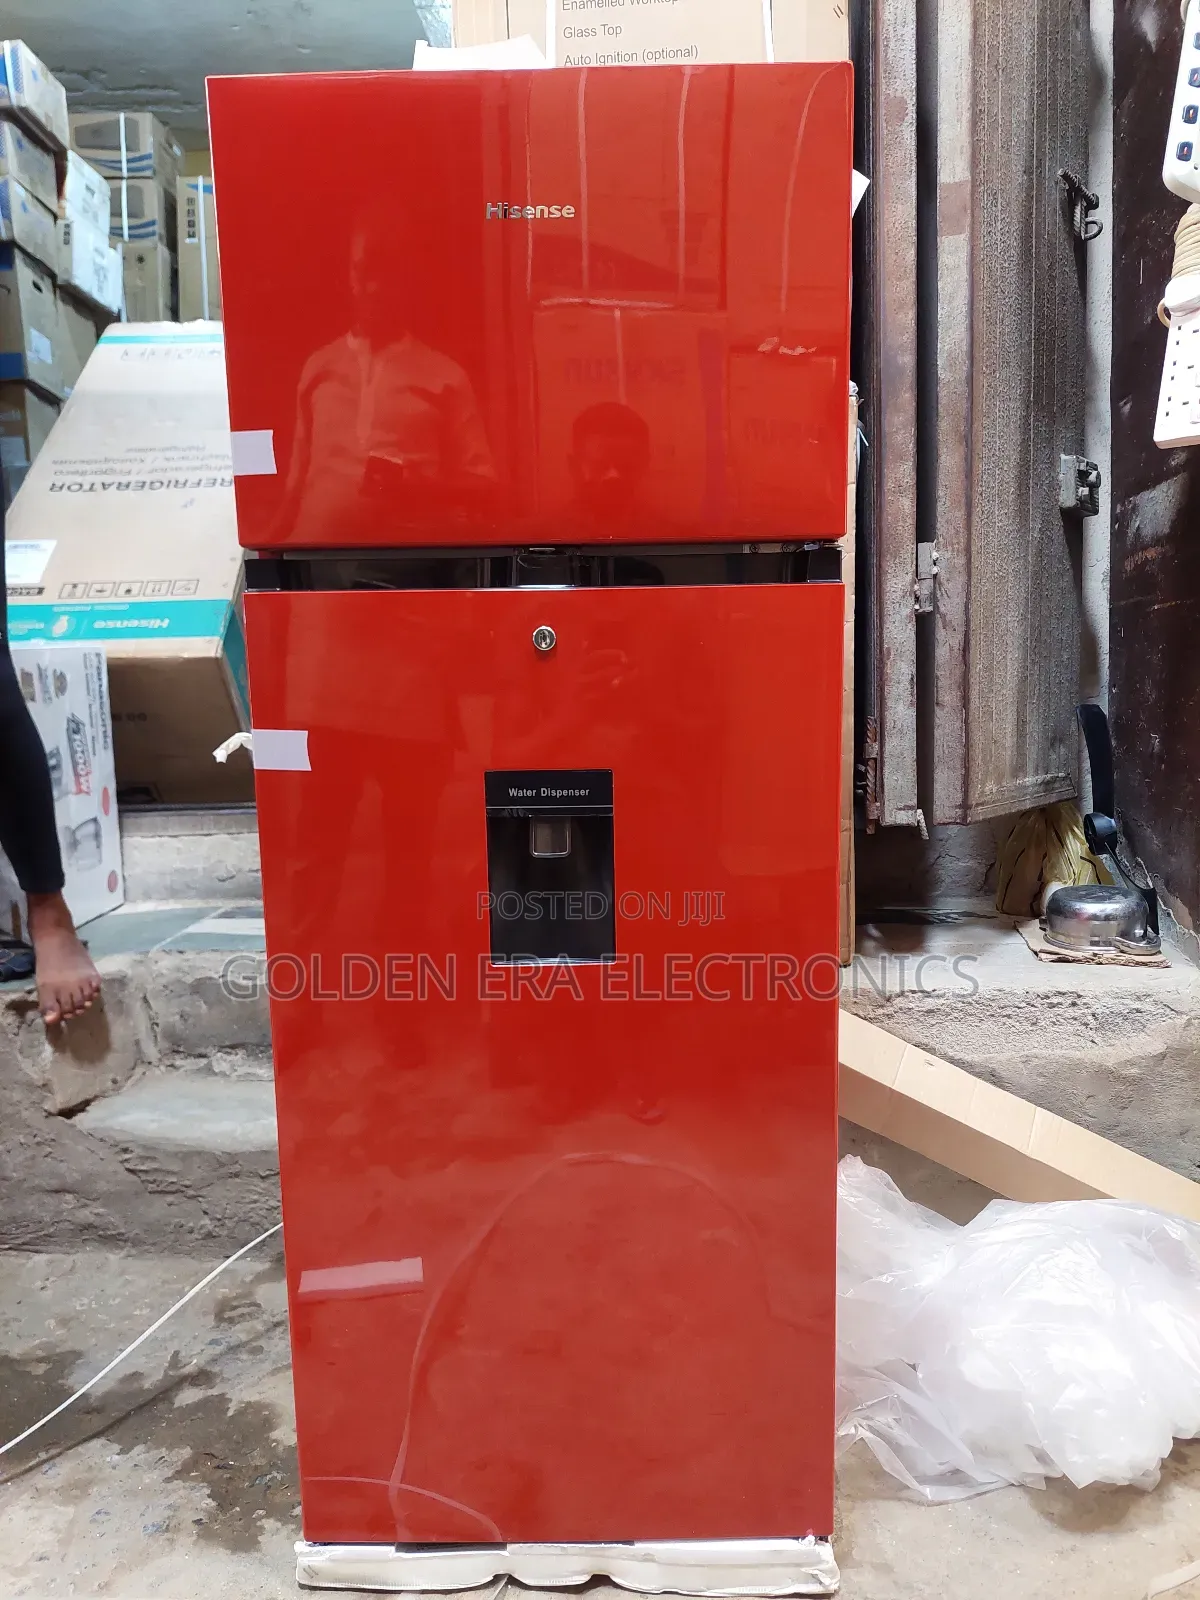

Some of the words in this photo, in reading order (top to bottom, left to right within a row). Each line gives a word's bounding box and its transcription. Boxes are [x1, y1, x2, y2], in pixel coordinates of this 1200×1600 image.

[562, 0, 625, 11] Enamelled
[563, 26, 597, 39] Glass
[600, 24, 622, 38] Top
[564, 54, 591, 66] Auto
[595, 51, 638, 66] Ignition
[642, 44, 698, 63] (optional)
[485, 202, 575, 220] Hisense
[93, 617, 170, 629] Hisense
[508, 787, 537, 797] Water
[540, 787, 590, 799] Dispenser
